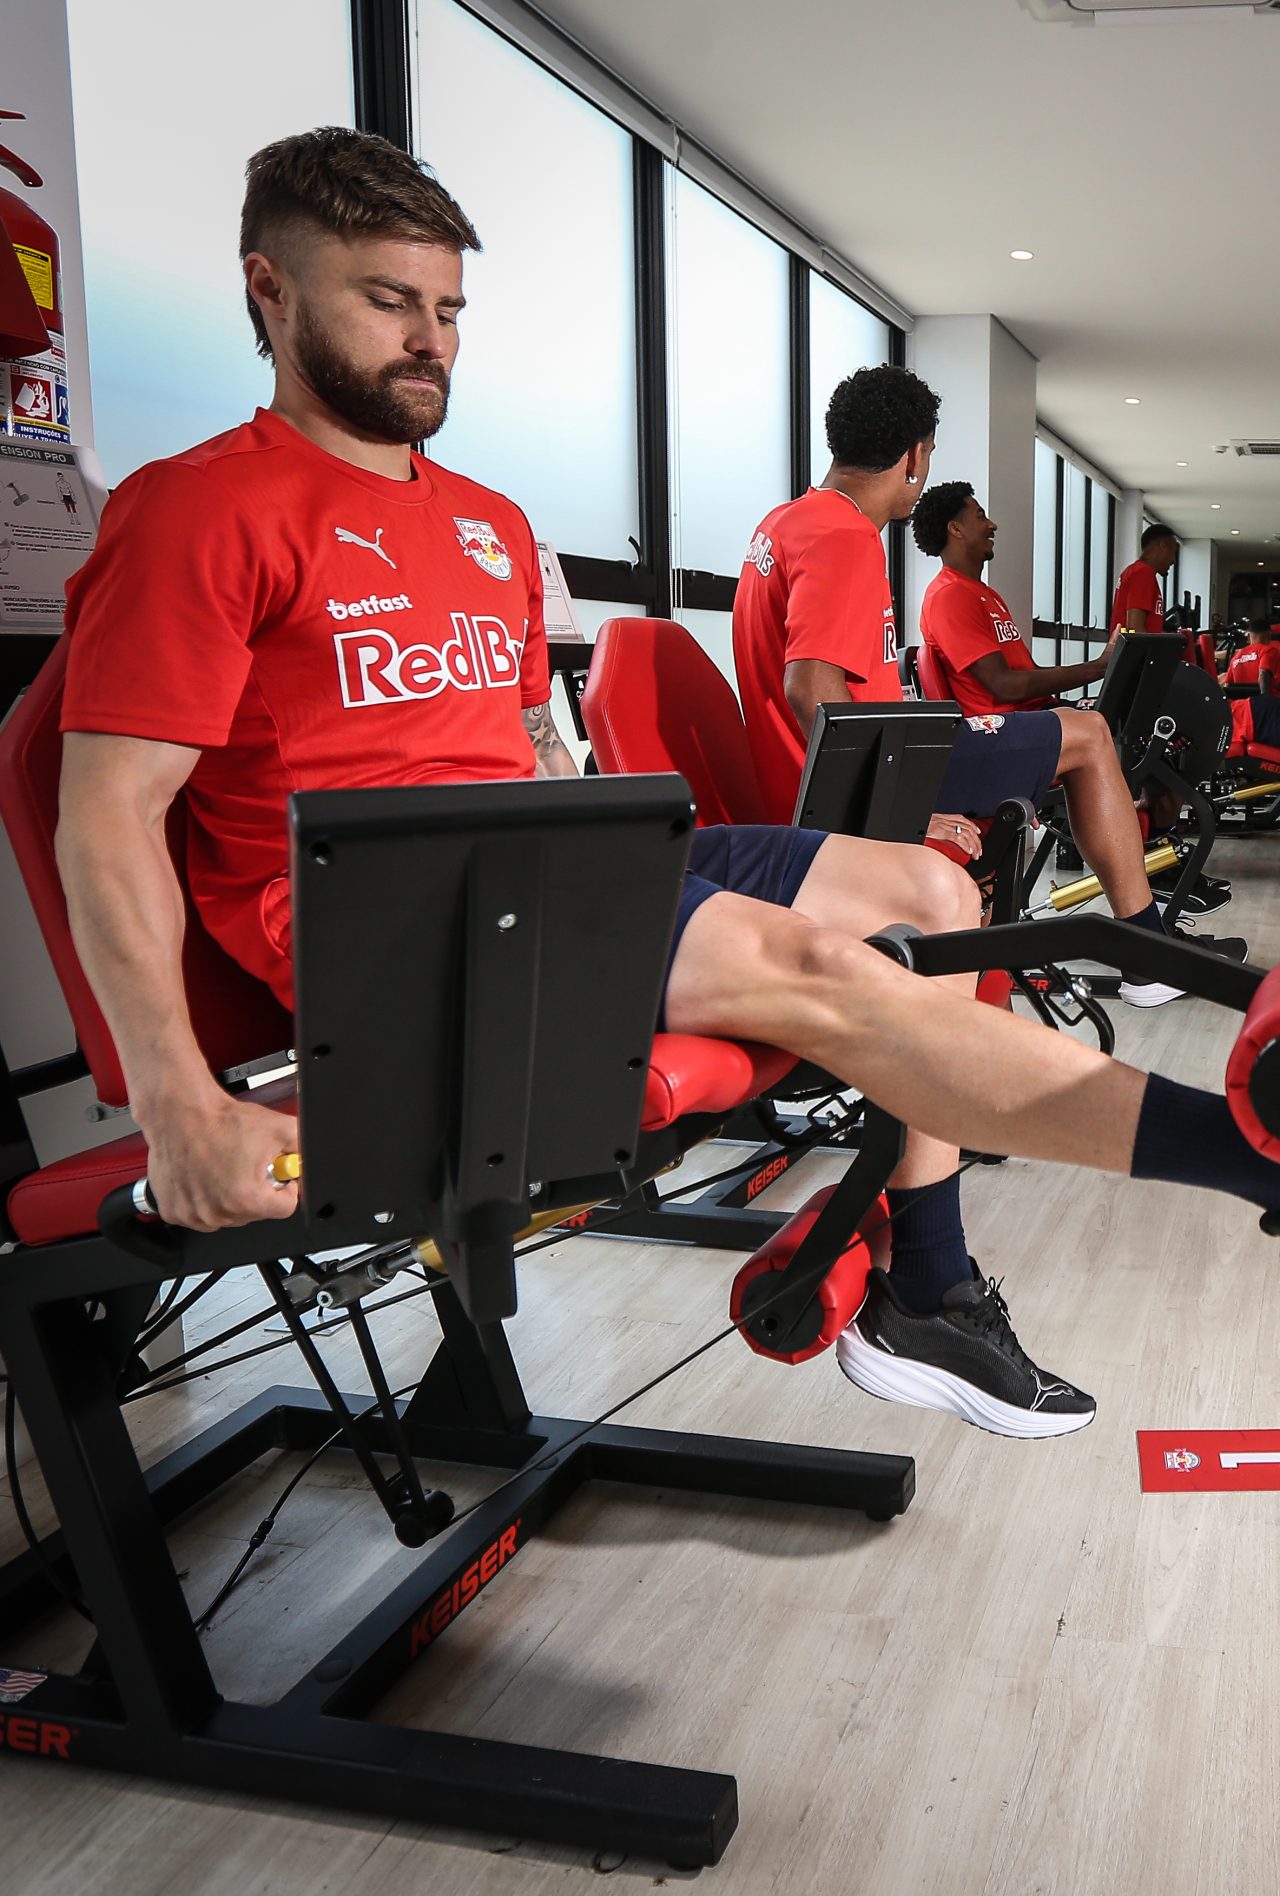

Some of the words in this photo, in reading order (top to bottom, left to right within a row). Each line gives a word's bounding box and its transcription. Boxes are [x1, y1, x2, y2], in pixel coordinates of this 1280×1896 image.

[44, 452, 67, 463] PRO
[325, 593, 413, 621] betfast
[410, 1524, 517, 1660] KEISER
[0, 1714, 71, 1759] ER
